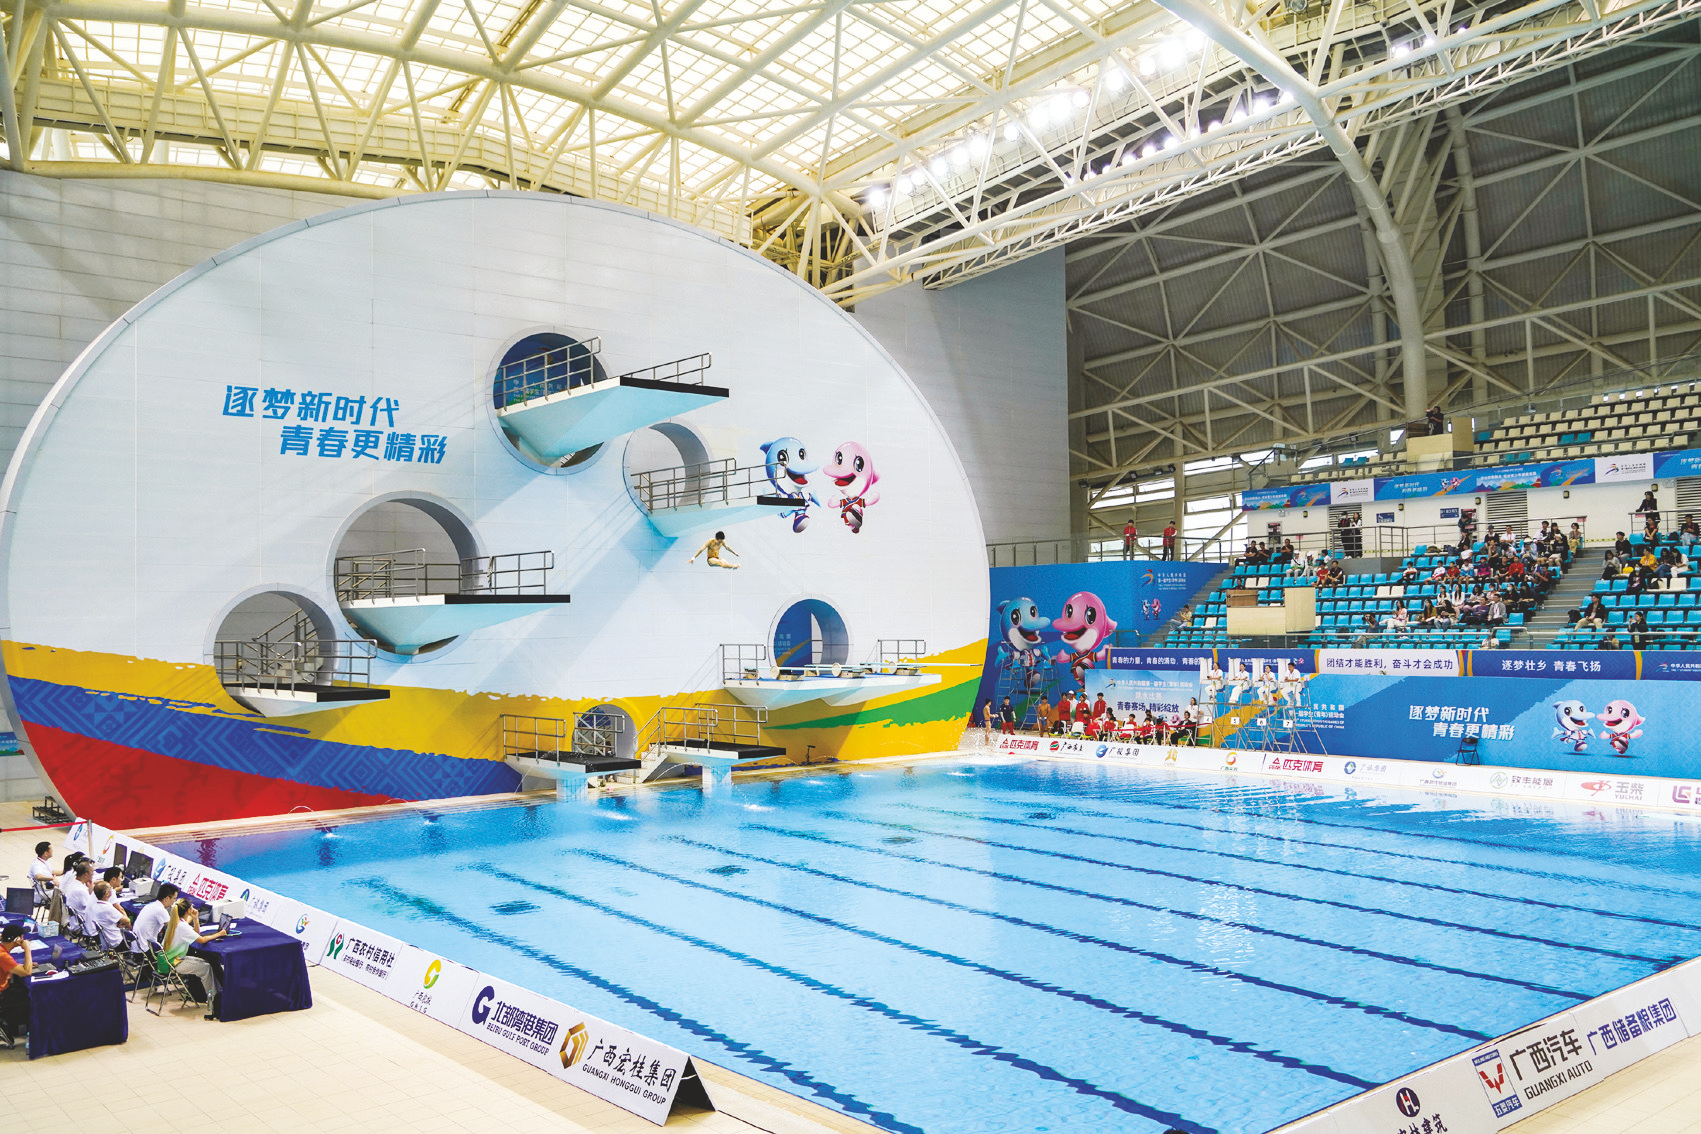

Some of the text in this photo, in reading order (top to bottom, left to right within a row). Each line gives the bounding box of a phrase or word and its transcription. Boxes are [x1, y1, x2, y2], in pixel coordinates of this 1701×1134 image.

[223, 385, 400, 427] 逐梦新时代
[280, 425, 447, 464] 青春更精彩
[1326, 658, 1453, 670] 团结才能胜利，奋斗才会成功
[1502, 660, 1601, 672] 逐梦壮乡 青春飞扬
[1409, 705, 1490, 722] 逐梦新时代
[1433, 722, 1515, 740] 青春更精彩
[1283, 759, 1324, 772] 匹克体育
[1615, 781, 1644, 795] 玉柴
[346, 937, 396, 968] 广西农村信用社
[486, 1022, 550, 1056] BEIBU GULF PORT GROUP
[491, 1000, 559, 1045] 北部湾港集团
[1587, 997, 1677, 1056] 广西储备粮集团
[587, 1038, 677, 1093] 广西宏桂集团
[1509, 1028, 1583, 1081] 广西汽车
[582, 1063, 667, 1105] GUANGXI HONGGUI GROUP
[1524, 1060, 1593, 1100] GUANGXI AUTO
